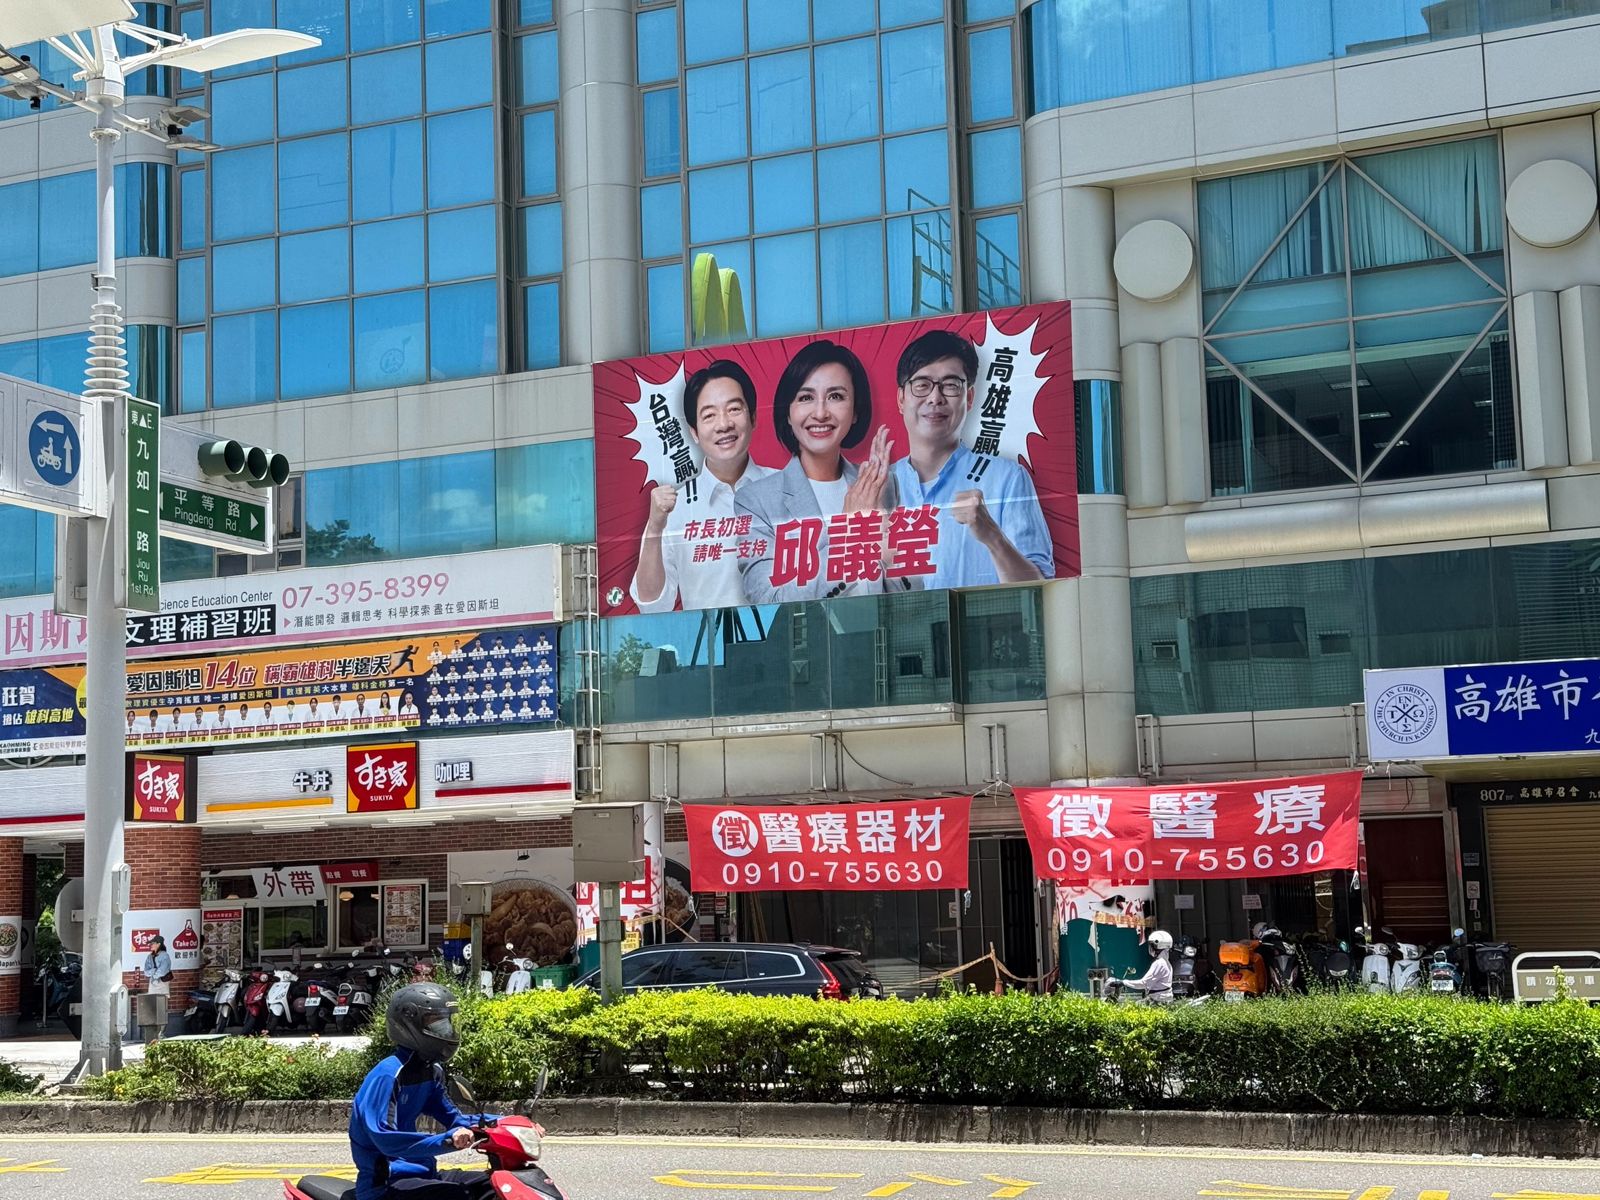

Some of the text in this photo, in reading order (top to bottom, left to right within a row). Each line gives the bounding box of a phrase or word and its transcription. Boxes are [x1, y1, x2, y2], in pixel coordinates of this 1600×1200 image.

[131, 410, 138, 425] 東
[136, 438, 150, 553] 九如一路
[174, 488, 240, 518] 平等路
[174, 507, 214, 528] Pingdeng
[683, 514, 753, 541] 市長初選
[692, 539, 768, 563] 請唯一支持
[769, 503, 941, 588] 邱議瑩
[136, 558, 150, 570] Jiou
[137, 570, 149, 582] Ru
[131, 583, 142, 594] 1st
[282, 572, 450, 609] 07-395-8399
[160, 591, 273, 611] cience Education Center
[293, 597, 500, 628] 潛能開發 邏輯思考 科學探索 盡在愛因斯坦
[126, 607, 272, 644] 文理補習班
[263, 653, 391, 685] 稱霸雄科半邊天
[2, 685, 36, 707] 狂賀
[1386, 686, 1425, 698] IN CHRIST
[1454, 669, 1600, 723] 高雄市
[2, 707, 74, 726] 搶佔 雄科高地
[138, 760, 180, 805] すき家
[292, 770, 333, 792] 牛丼
[354, 752, 408, 793] すき家
[434, 761, 473, 783] 咖哩
[369, 794, 394, 802] SUKIYA
[1480, 789, 1505, 801] 807
[149, 806, 168, 814] SUKIYA
[1048, 840, 1325, 873] 0910-755630
[262, 870, 316, 898] 外帶
[722, 860, 943, 885] 0910-755630
[175, 940, 190, 948] Take
